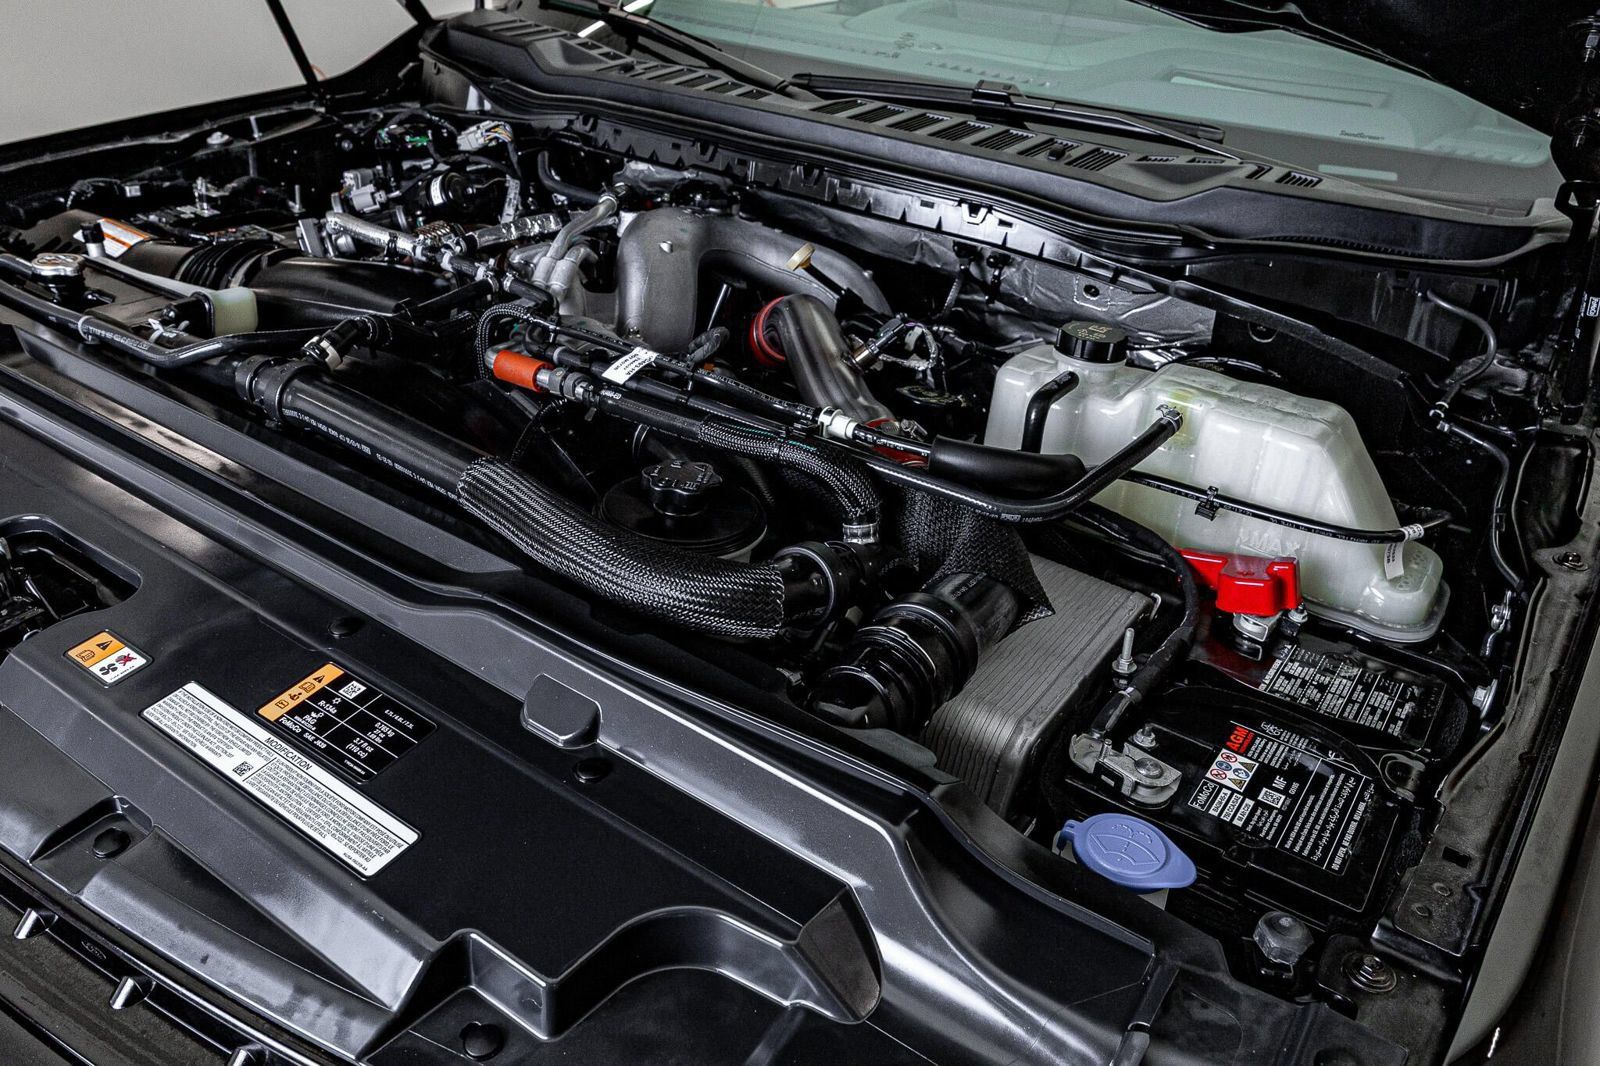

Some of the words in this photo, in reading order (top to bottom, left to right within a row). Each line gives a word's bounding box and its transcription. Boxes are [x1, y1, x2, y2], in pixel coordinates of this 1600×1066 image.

[317, 700, 338, 714] R-134a
[278, 716, 303, 733] FoMoCo
[302, 732, 315, 741] SAE
[302, 714, 317, 724] PAG
[1225, 726, 1248, 751] AGM
[263, 737, 313, 770] MODIFICATION
[1272, 775, 1288, 790] MF
[1193, 782, 1215, 808] FoMoCo
[1223, 811, 1231, 819] 750
